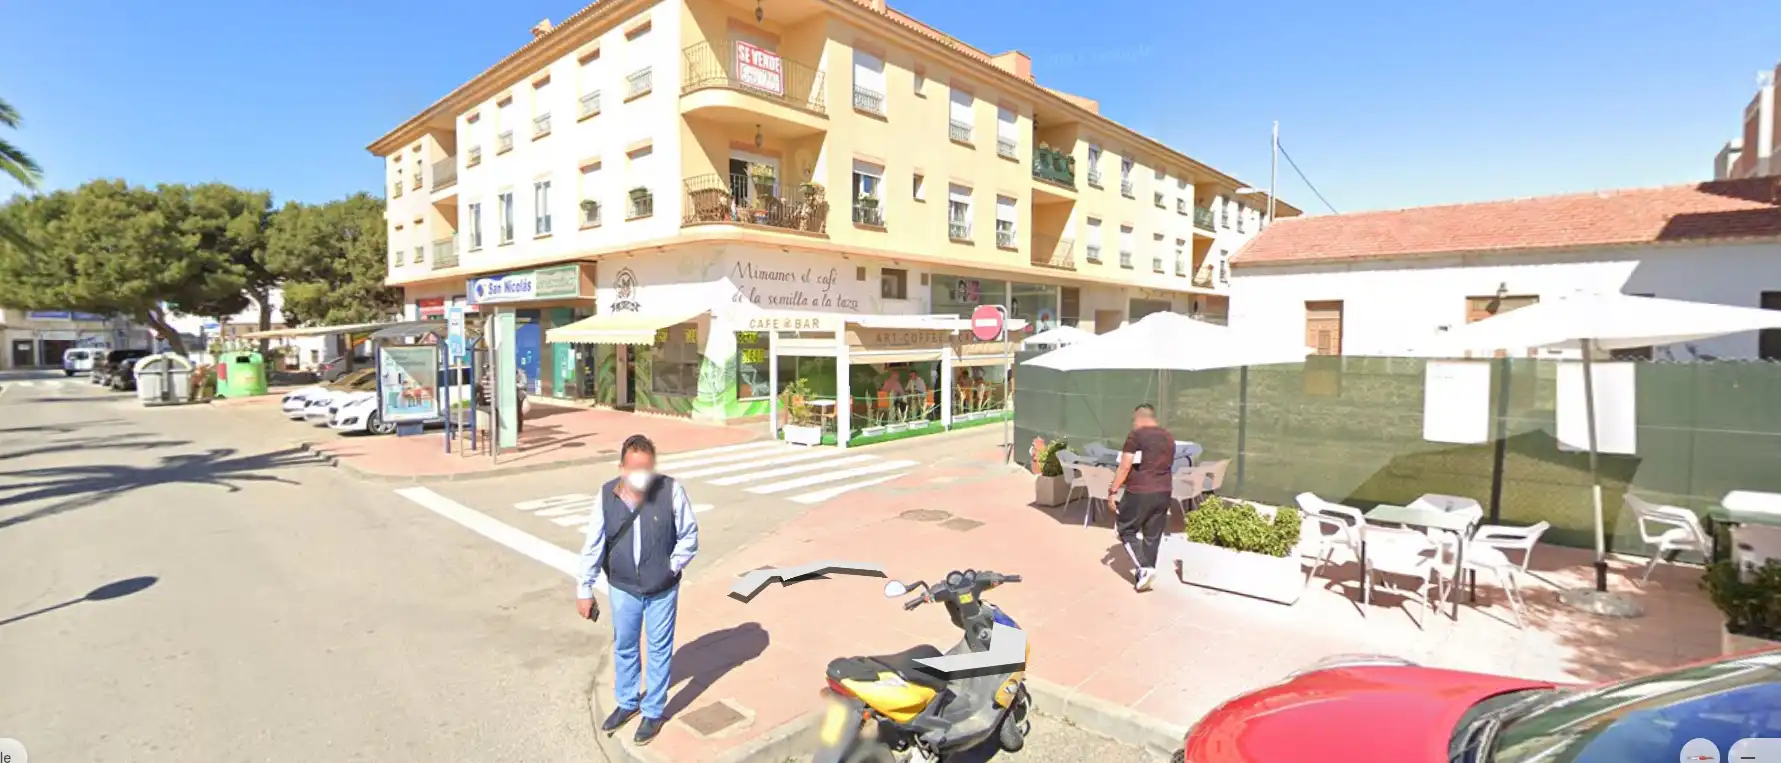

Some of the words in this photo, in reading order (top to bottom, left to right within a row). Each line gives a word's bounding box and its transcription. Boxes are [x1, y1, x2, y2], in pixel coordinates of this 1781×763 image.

[738, 43, 751, 64] SE
[751, 48, 781, 74] VENDE
[801, 268, 812, 284] el
[488, 283, 502, 295] San
[504, 279, 532, 293] Nicolás
[749, 287, 761, 304] la
[768, 291, 808, 307] semilla
[812, 298, 819, 307] a
[821, 293, 832, 308] la
[837, 293, 860, 312] taza
[749, 319, 779, 329] CAFE
[794, 318, 820, 329] BAR
